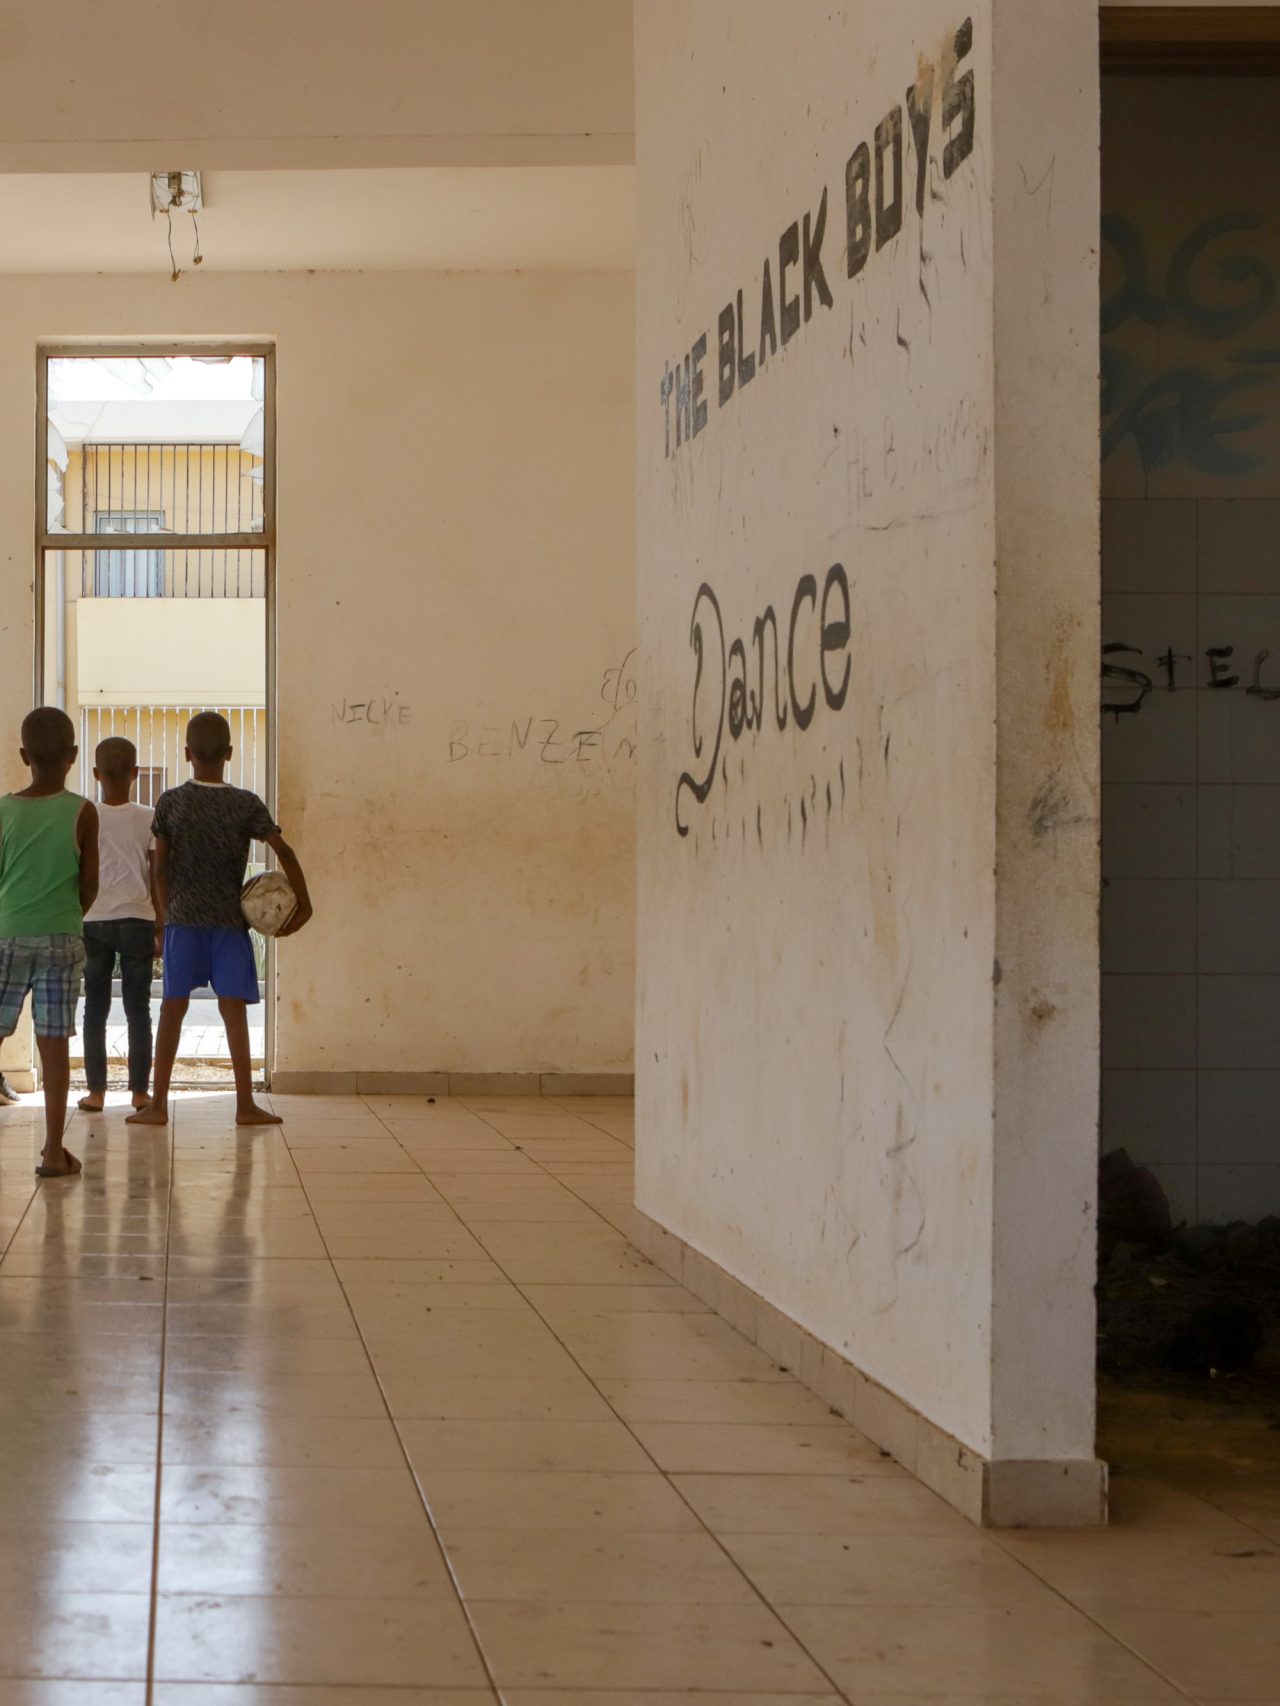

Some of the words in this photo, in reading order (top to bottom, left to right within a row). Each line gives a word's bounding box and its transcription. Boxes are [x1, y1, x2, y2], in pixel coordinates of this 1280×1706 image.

[661, 331, 708, 458] THE
[718, 184, 833, 408] BLACK
[845, 16, 974, 279] BOYS
[676, 563, 851, 837] Dance
